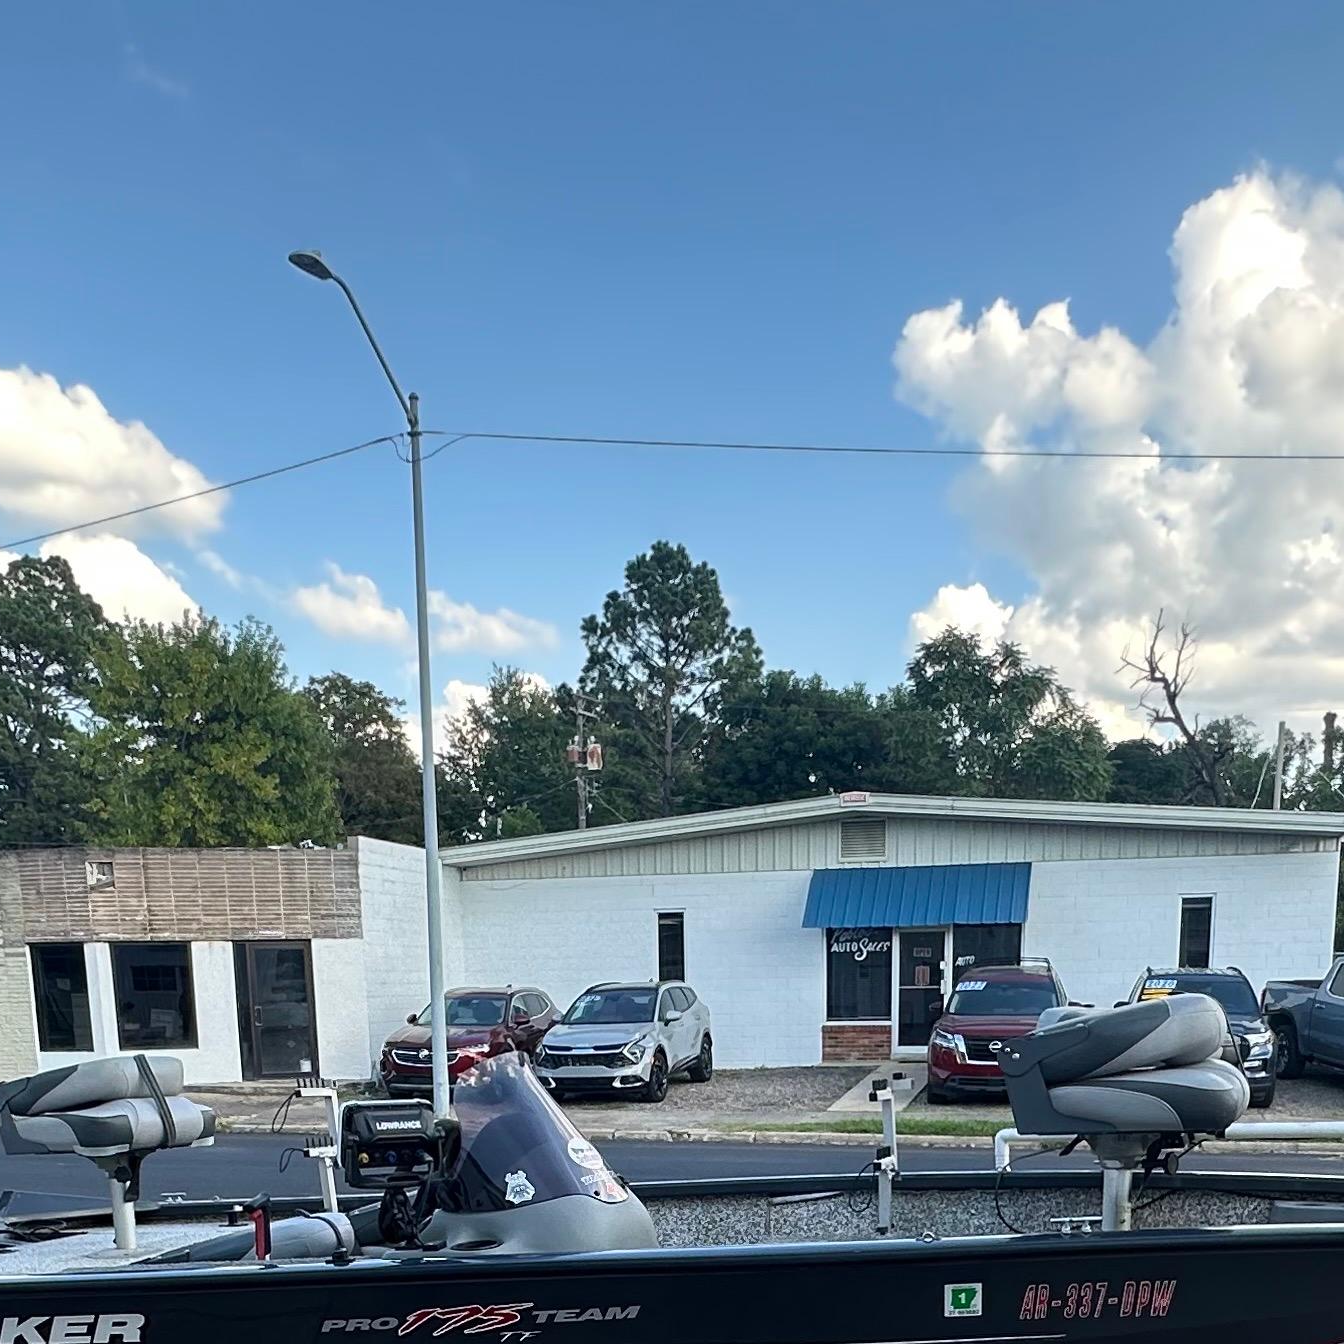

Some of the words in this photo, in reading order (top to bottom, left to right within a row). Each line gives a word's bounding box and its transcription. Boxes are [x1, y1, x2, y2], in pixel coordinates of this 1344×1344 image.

[831, 942, 858, 953] AUTO
[955, 955, 975, 966] AUTO
[376, 1120, 422, 1130] LOWRANCE
[321, 1316, 400, 1333] PRO
[398, 1302, 534, 1336] 175
[531, 1305, 641, 1323] TEAM
